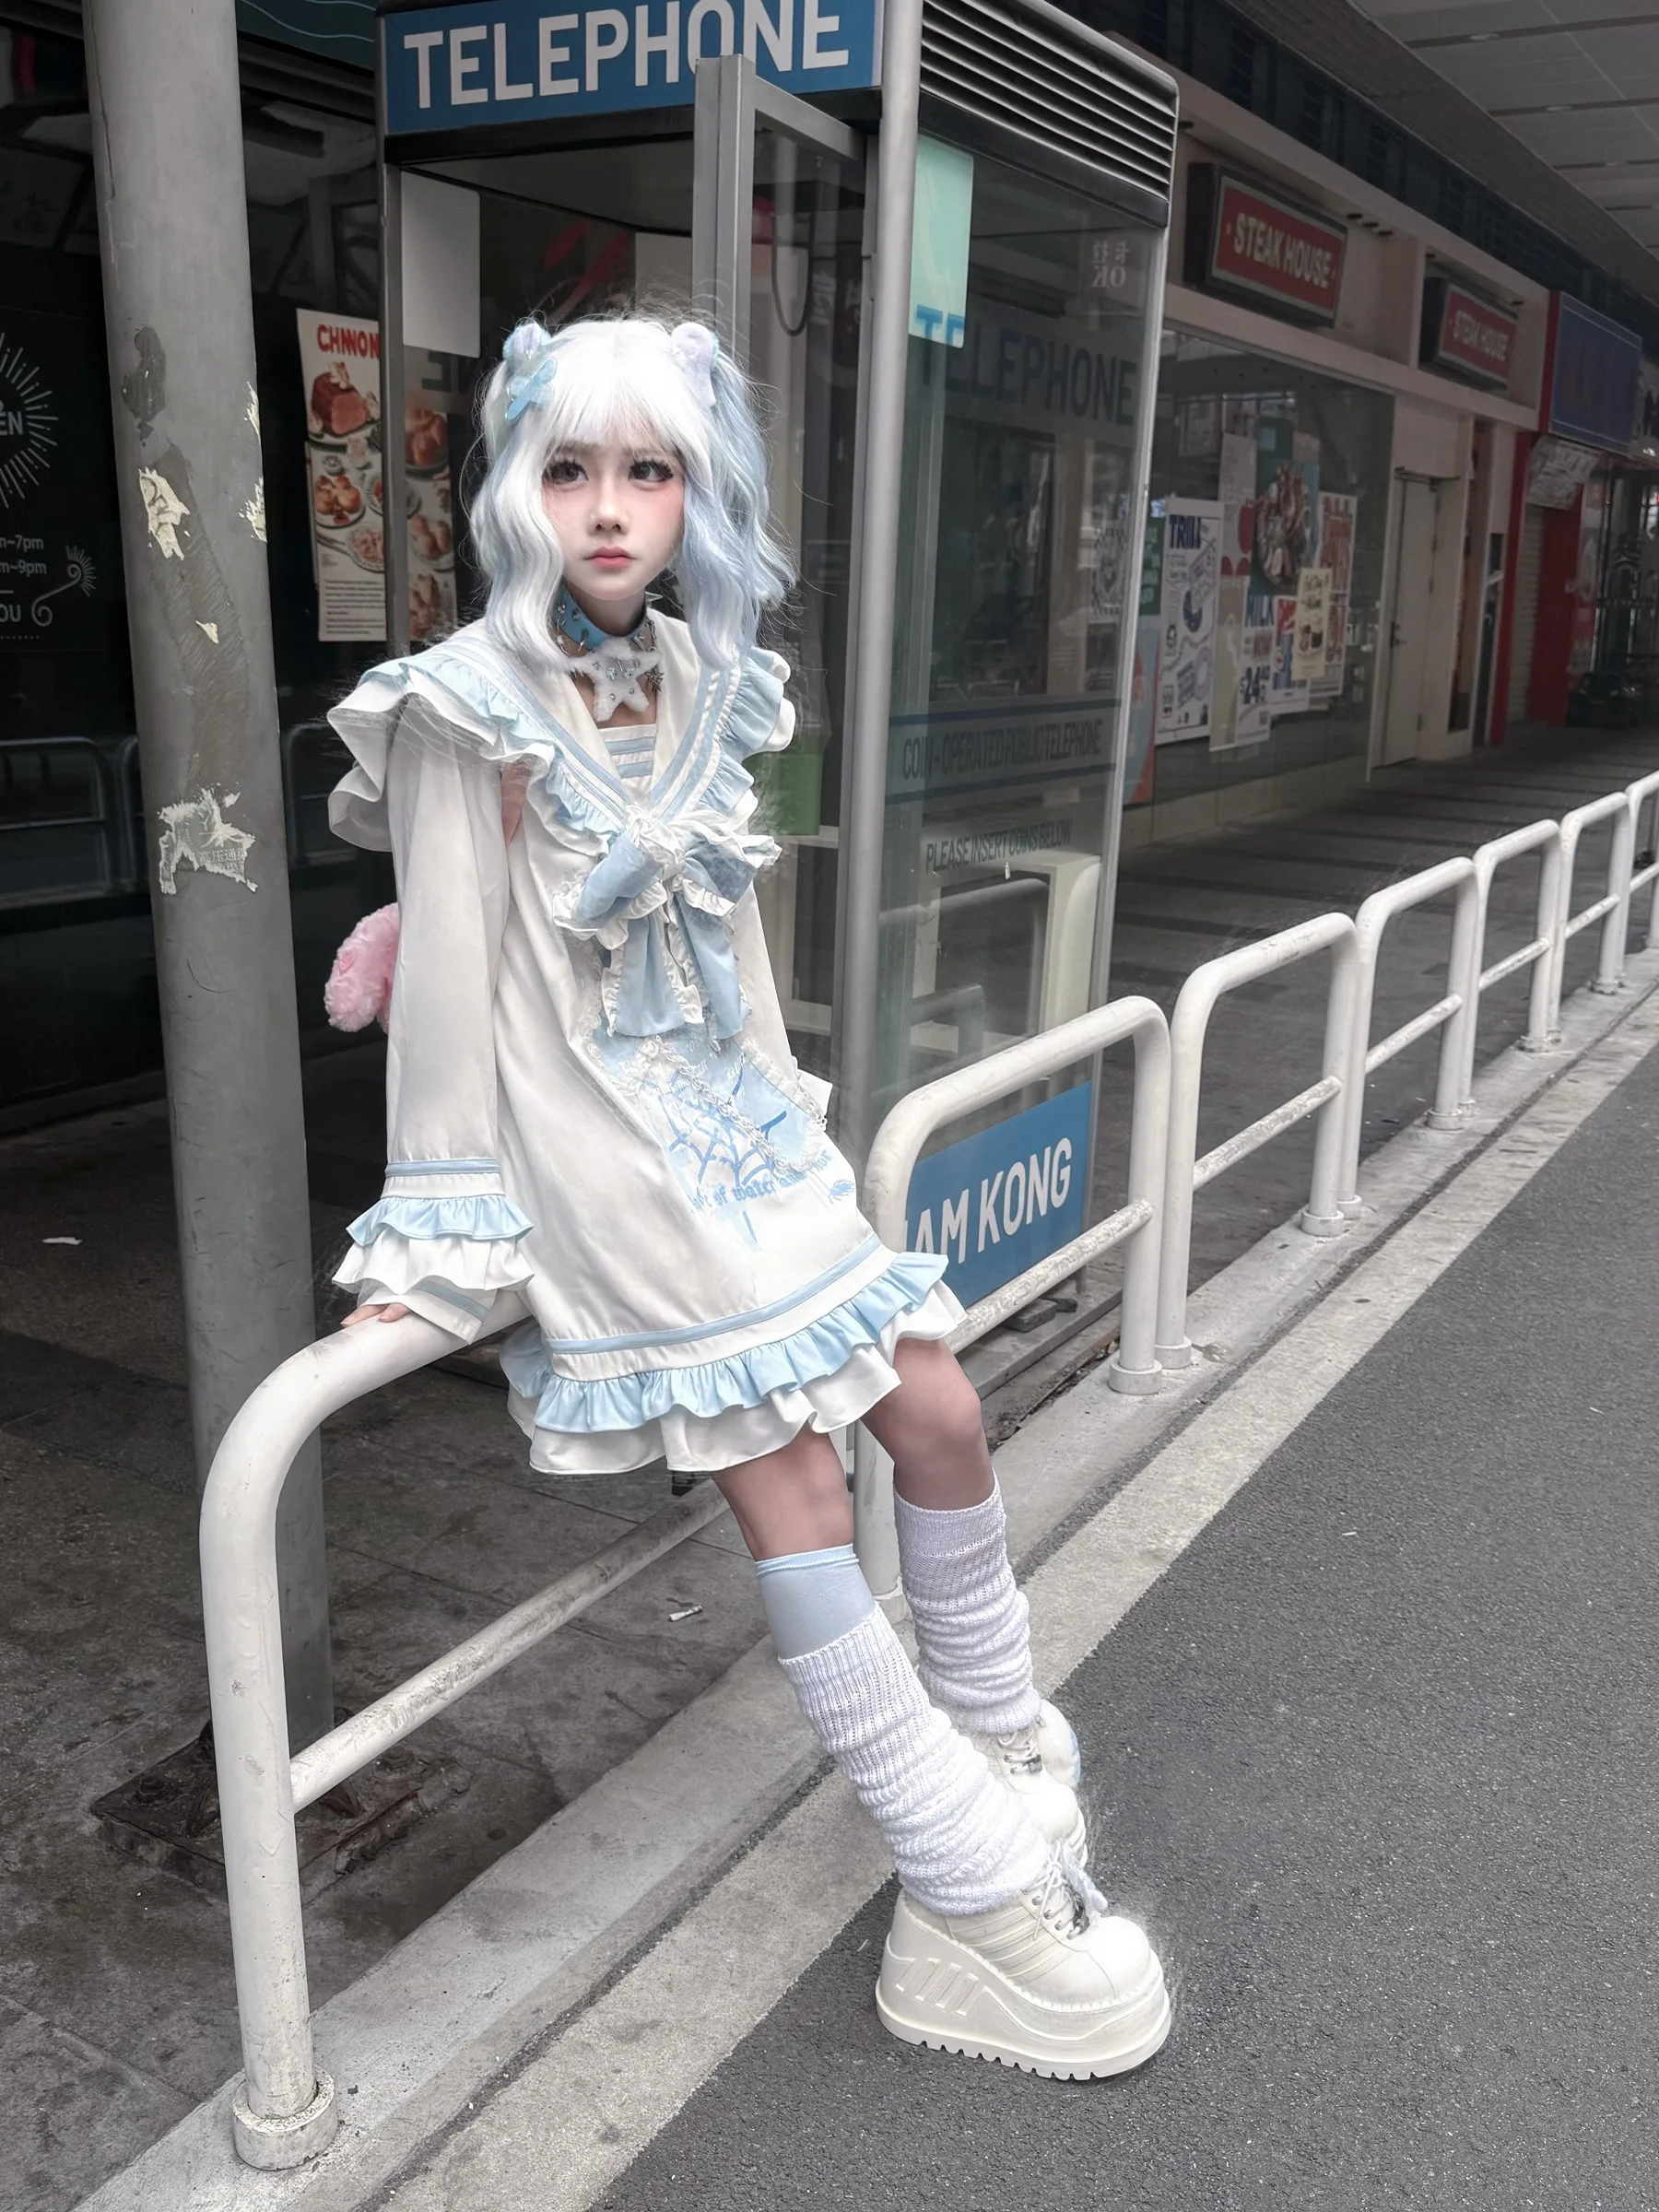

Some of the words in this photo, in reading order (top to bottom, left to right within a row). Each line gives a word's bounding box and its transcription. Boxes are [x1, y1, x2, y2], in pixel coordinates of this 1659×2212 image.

[404, 0, 849, 109] TELEPHONE
[1233, 212, 1282, 269] STEAK
[1286, 237, 1332, 289] HOUSE
[916, 304, 1137, 426] TELEPHONE
[925, 838, 971, 874] PLEASE
[971, 830, 1009, 865] INSERT
[905, 1189, 970, 1265] AM
[978, 1136, 1073, 1253] KONG
